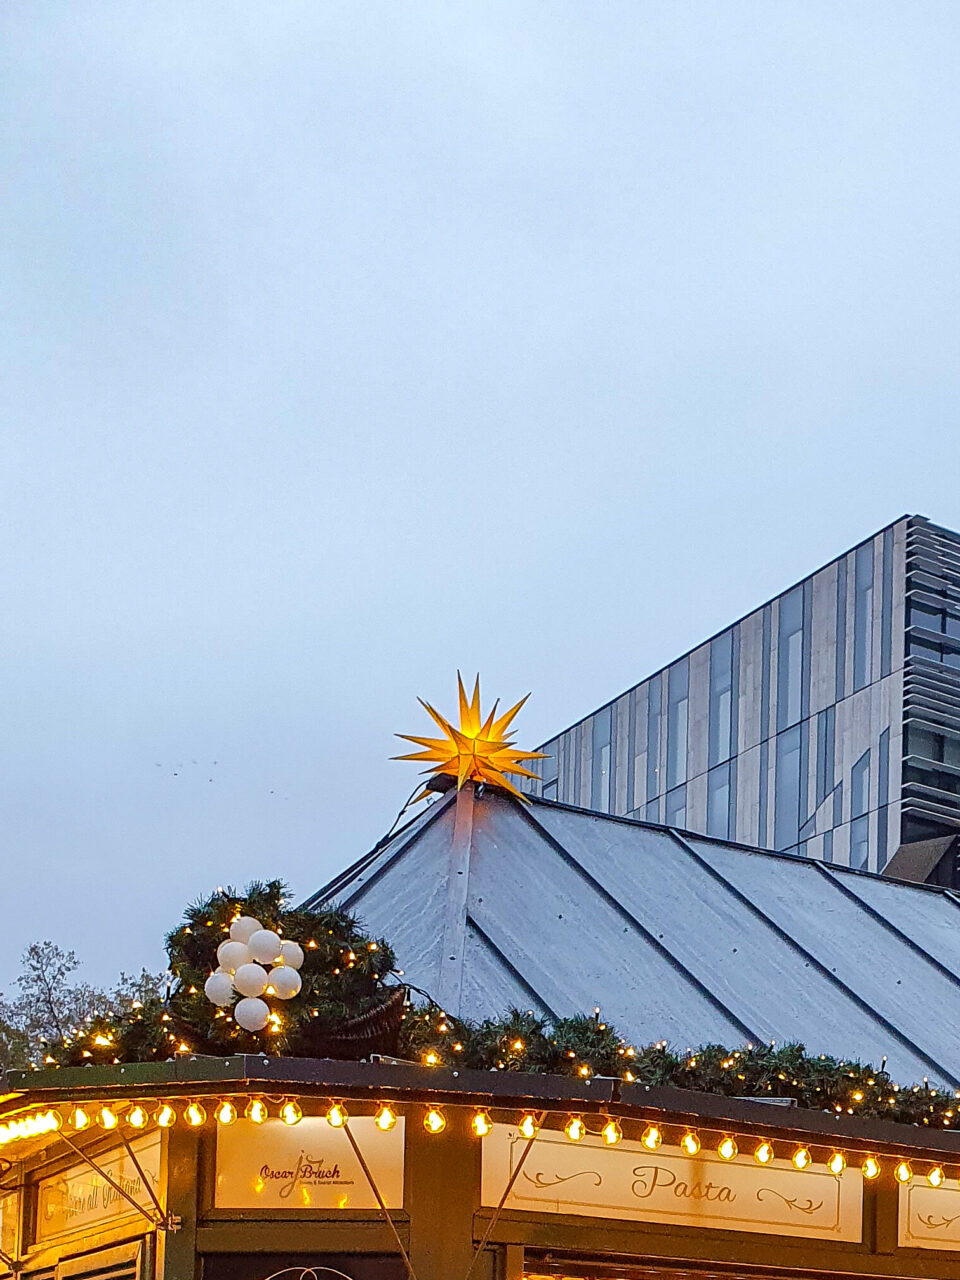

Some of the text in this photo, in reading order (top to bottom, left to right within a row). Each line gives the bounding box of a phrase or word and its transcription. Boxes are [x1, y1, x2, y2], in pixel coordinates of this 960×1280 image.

[259, 1163, 341, 1180] Oscar Bruch
[631, 1165, 737, 1203] Pasta
